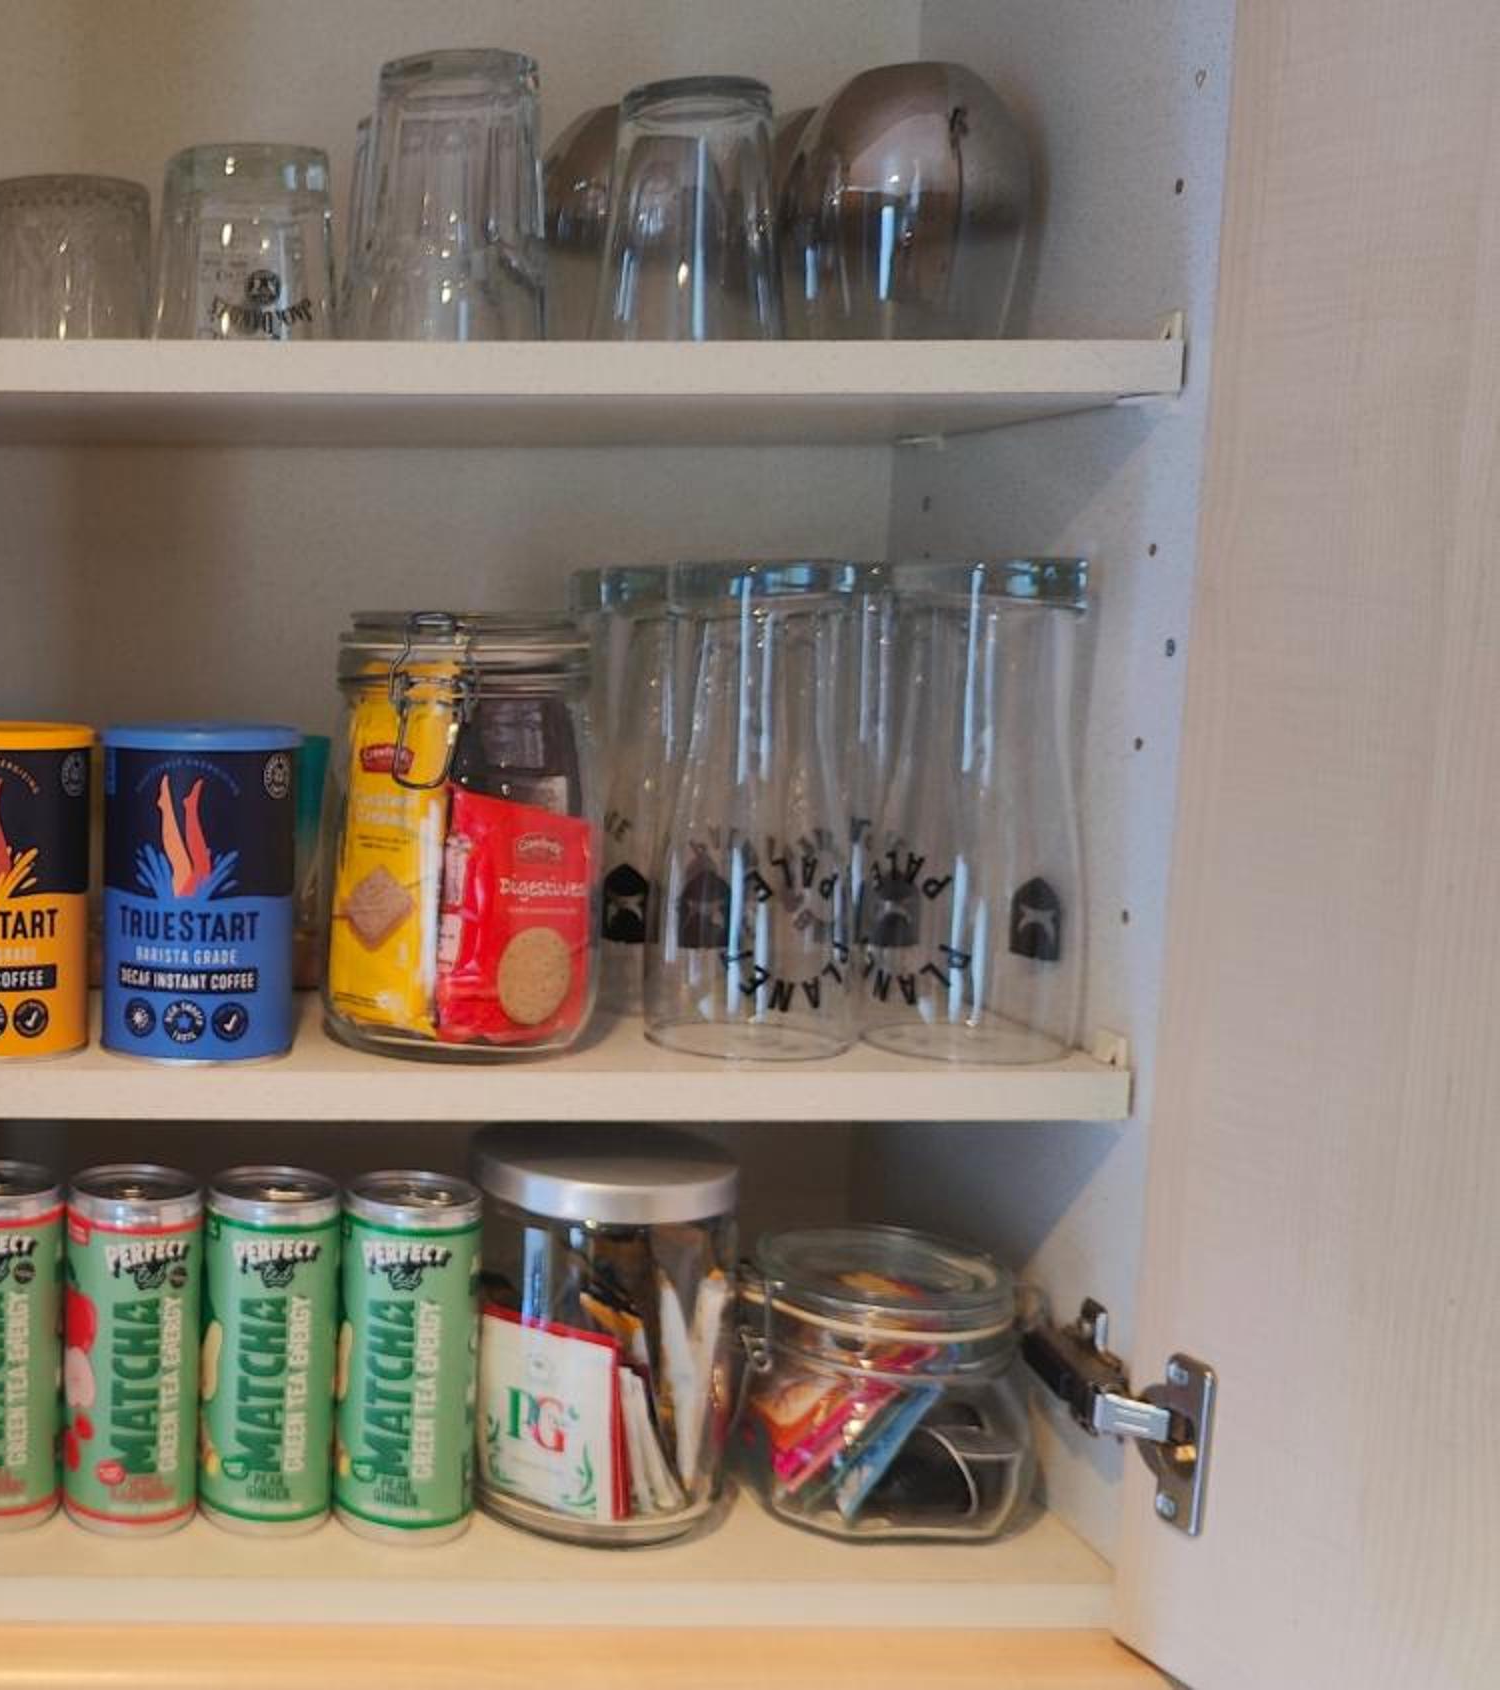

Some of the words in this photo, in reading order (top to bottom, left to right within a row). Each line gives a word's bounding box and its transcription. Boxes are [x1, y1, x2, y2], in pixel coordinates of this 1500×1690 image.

[121, 967, 152, 986] DECAF
[153, 972, 207, 990] INSTANT
[210, 972, 256, 990] COFFEE
[135, 945, 189, 965] BARISTA
[193, 947, 237, 966] GRADE
[105, 1241, 188, 1272] PERFECT
[233, 1240, 320, 1267] PERFECT
[363, 1240, 451, 1268] PERFECT
[5, 1291, 29, 1363] ENERGY
[160, 1297, 182, 1367] ENERGY
[288, 1297, 311, 1369] ENERGY
[416, 1300, 440, 1374] ENERGY
[4, 1365, 28, 1403] TEA
[110, 1299, 160, 1474] MATCHA
[159, 1372, 181, 1409] TEA
[236, 1297, 287, 1472] MATCHA
[286, 1372, 308, 1409] TEA
[363, 1299, 414, 1477] MATCHA
[414, 1376, 438, 1415] TEA
[4, 1406, 28, 1466] GREEN
[158, 1412, 179, 1472] GREEN
[283, 1411, 307, 1472] GREEN
[410, 1418, 436, 1479] GREEN
[505, 1386, 567, 1453] PG
[246, 1486, 290, 1501] GINGER
[373, 1486, 419, 1506] GINGER
